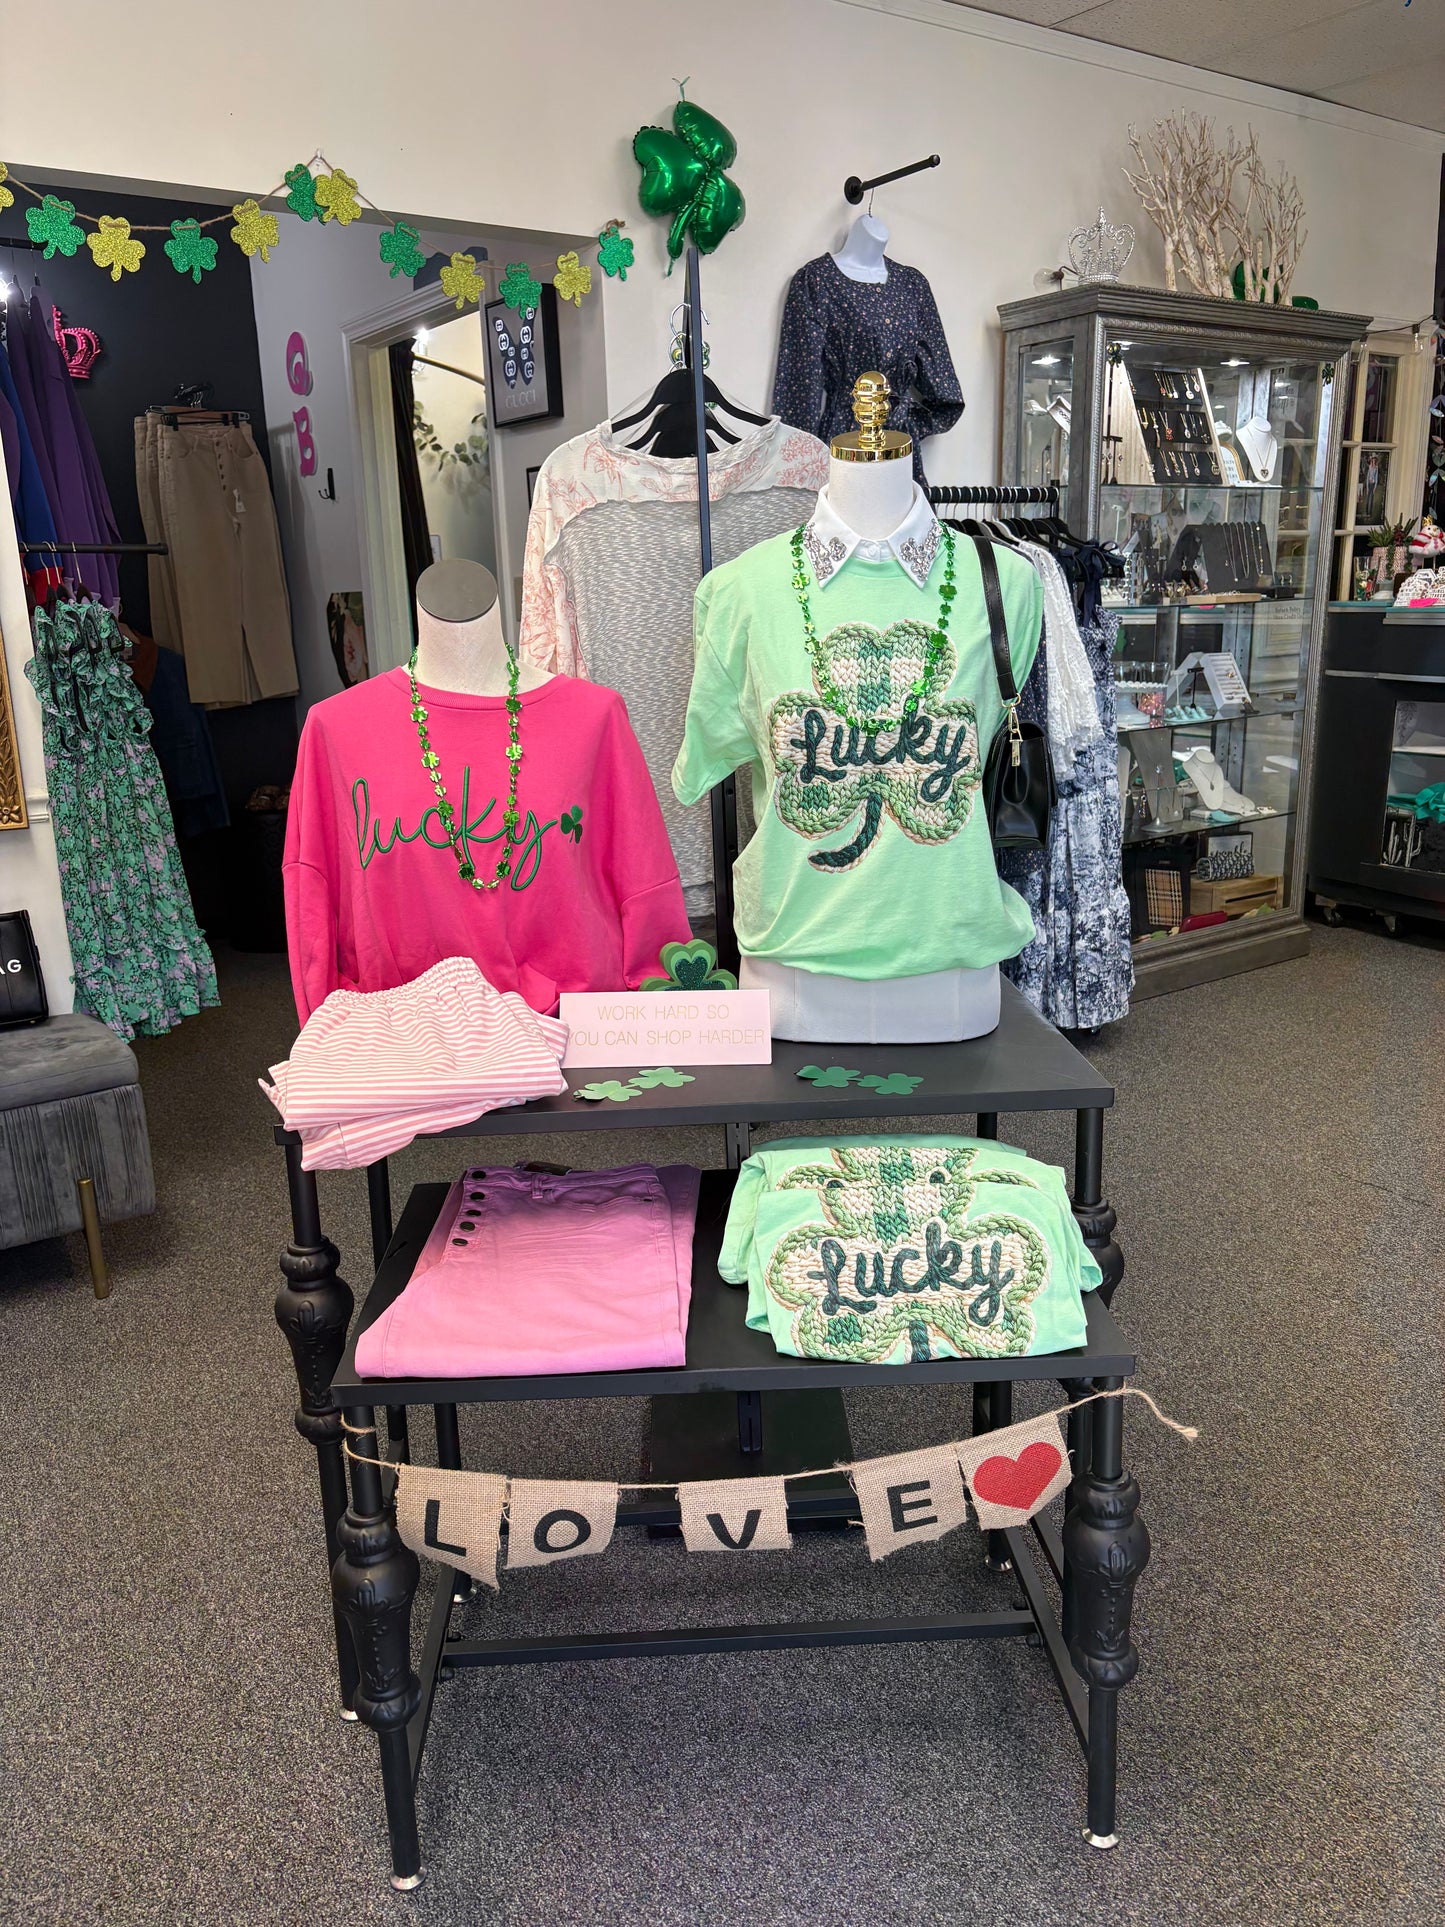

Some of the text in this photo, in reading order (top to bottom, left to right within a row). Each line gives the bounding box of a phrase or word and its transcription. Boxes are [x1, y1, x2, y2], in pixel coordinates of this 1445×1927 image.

[791, 694, 970, 803] Lucky
[352, 766, 558, 891] lucky
[597, 1004, 730, 1021] WORK HARD SO
[604, 1030, 638, 1046] CAN
[646, 1029, 692, 1046] SHOP
[700, 1028, 765, 1045] HARDER
[807, 1221, 1015, 1326] Lucky
